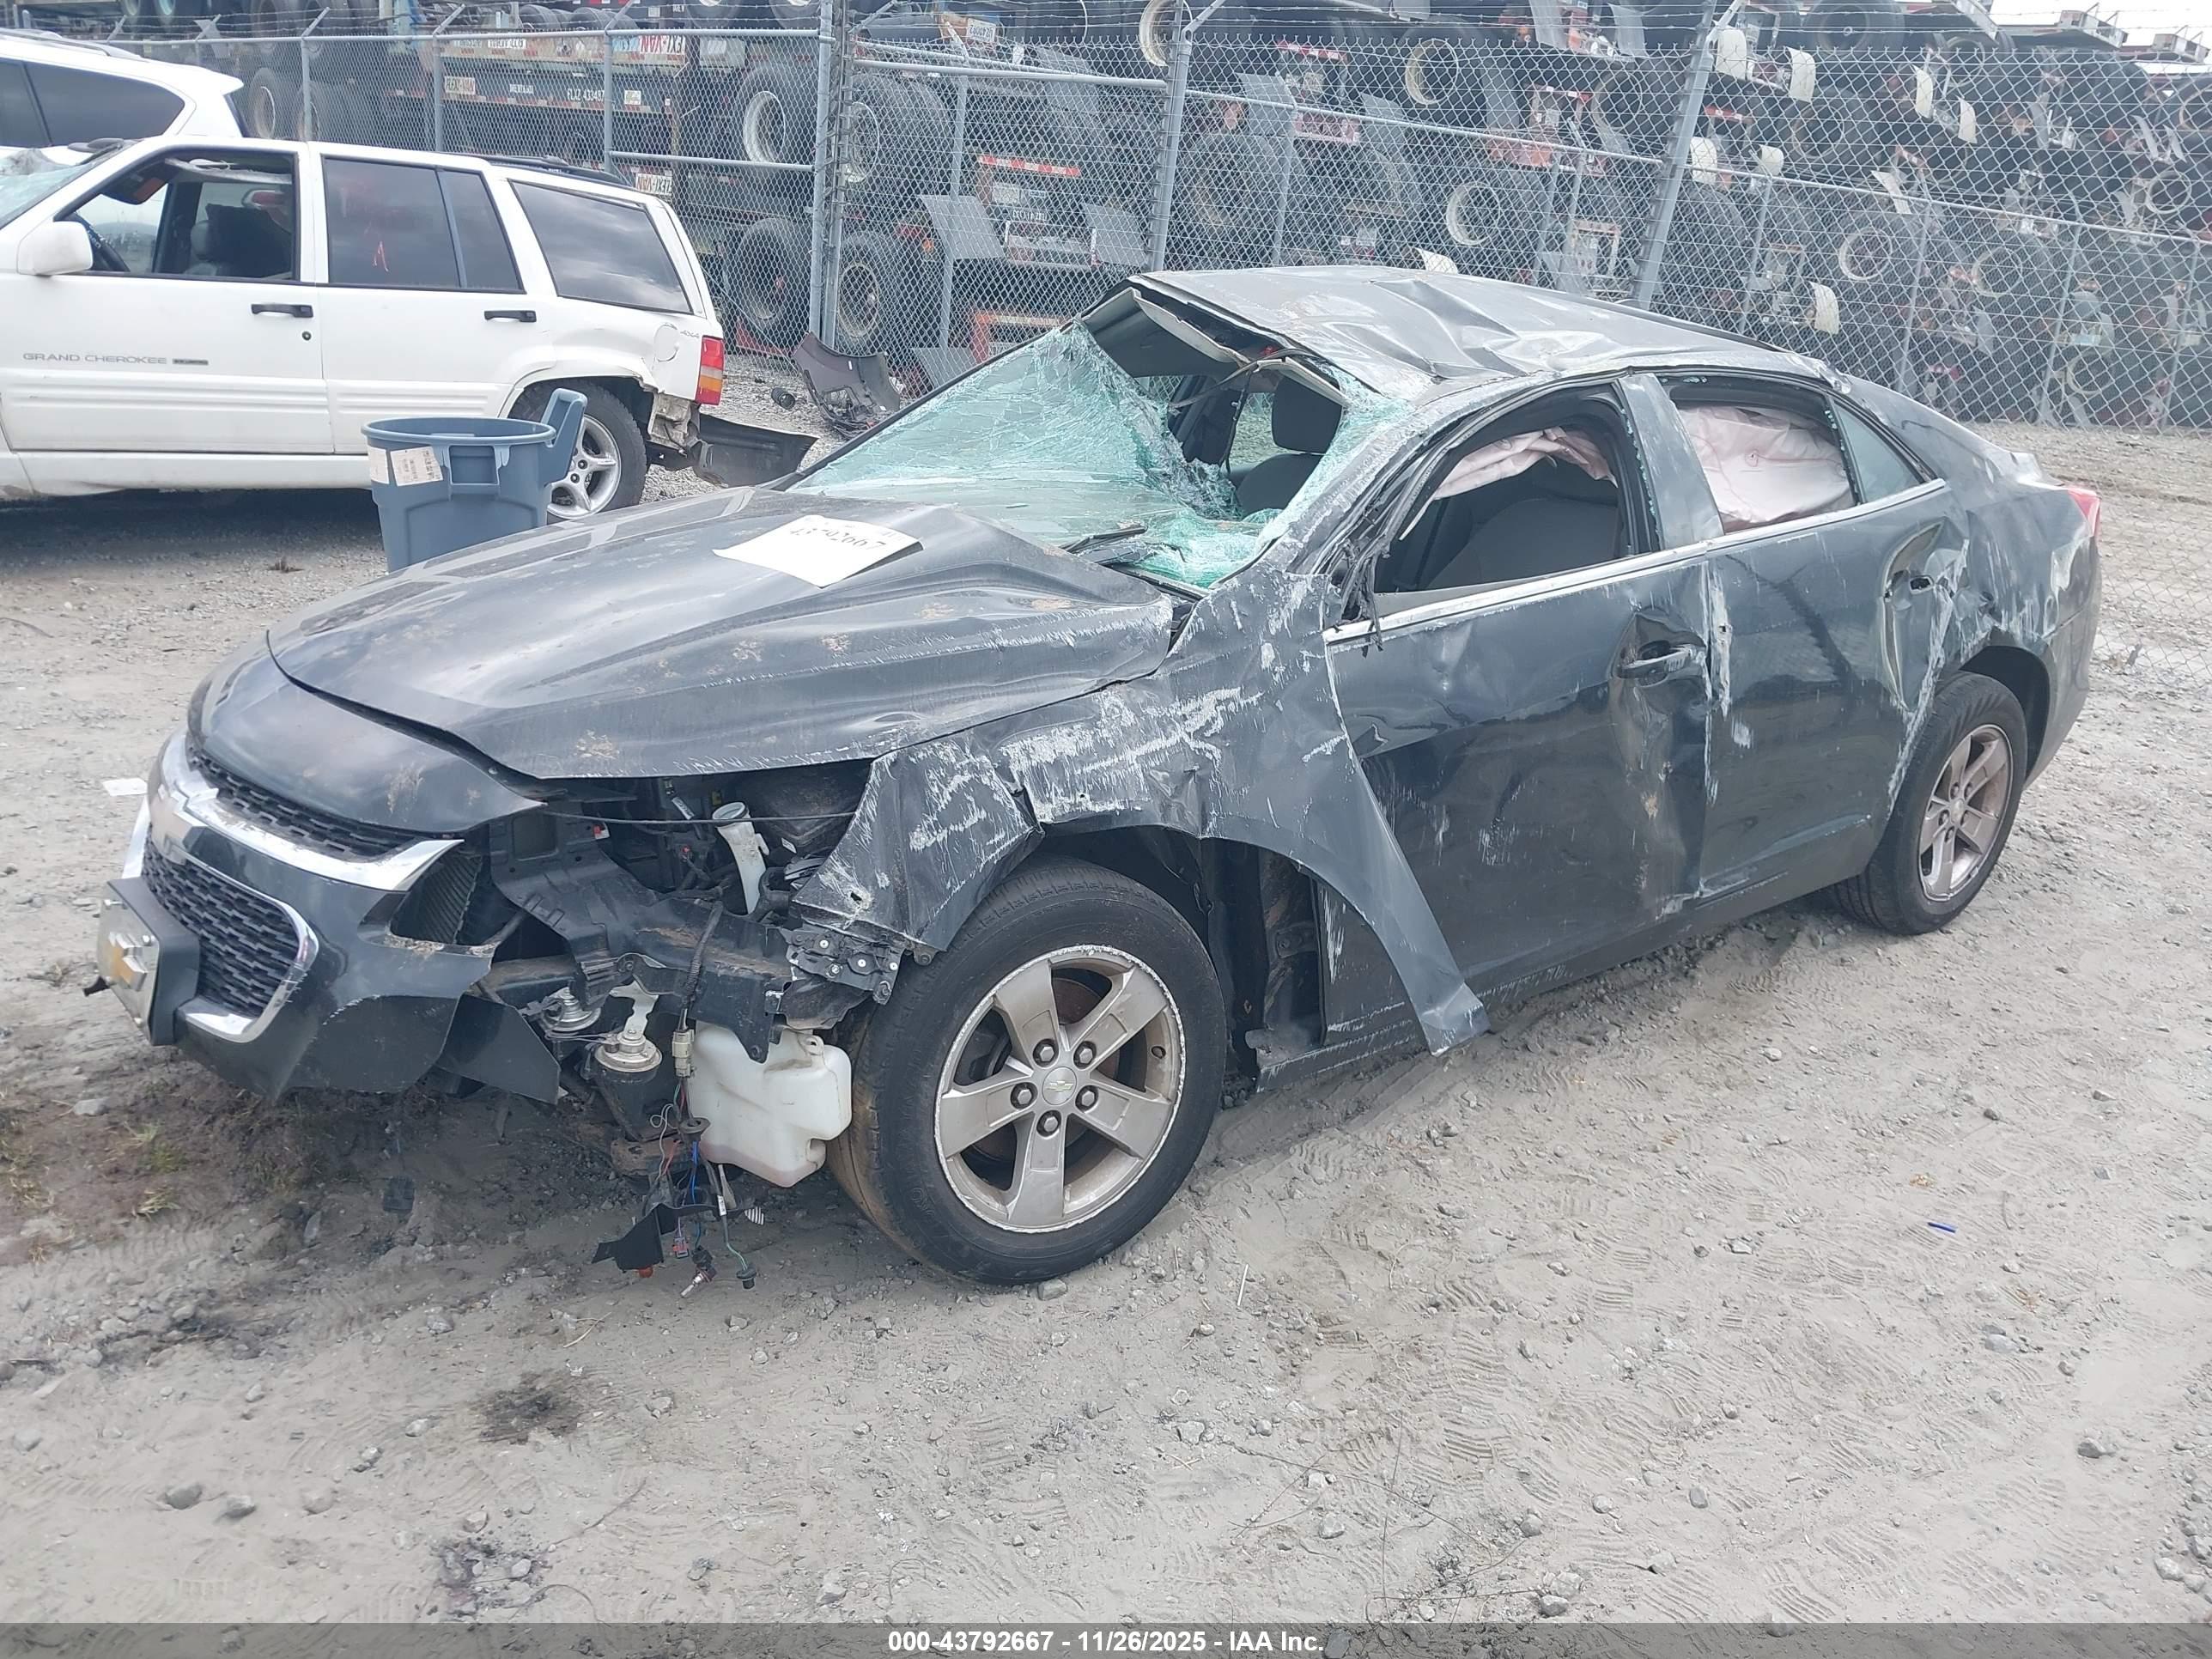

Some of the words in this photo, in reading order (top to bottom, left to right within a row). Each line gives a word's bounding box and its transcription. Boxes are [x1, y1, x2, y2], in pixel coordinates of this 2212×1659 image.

[641, 35, 684, 53] EXI-VAN
[568, 88, 581, 100] FLXZ
[22, 352, 81, 362] GRAND
[84, 354, 167, 364] CHEROKEE
